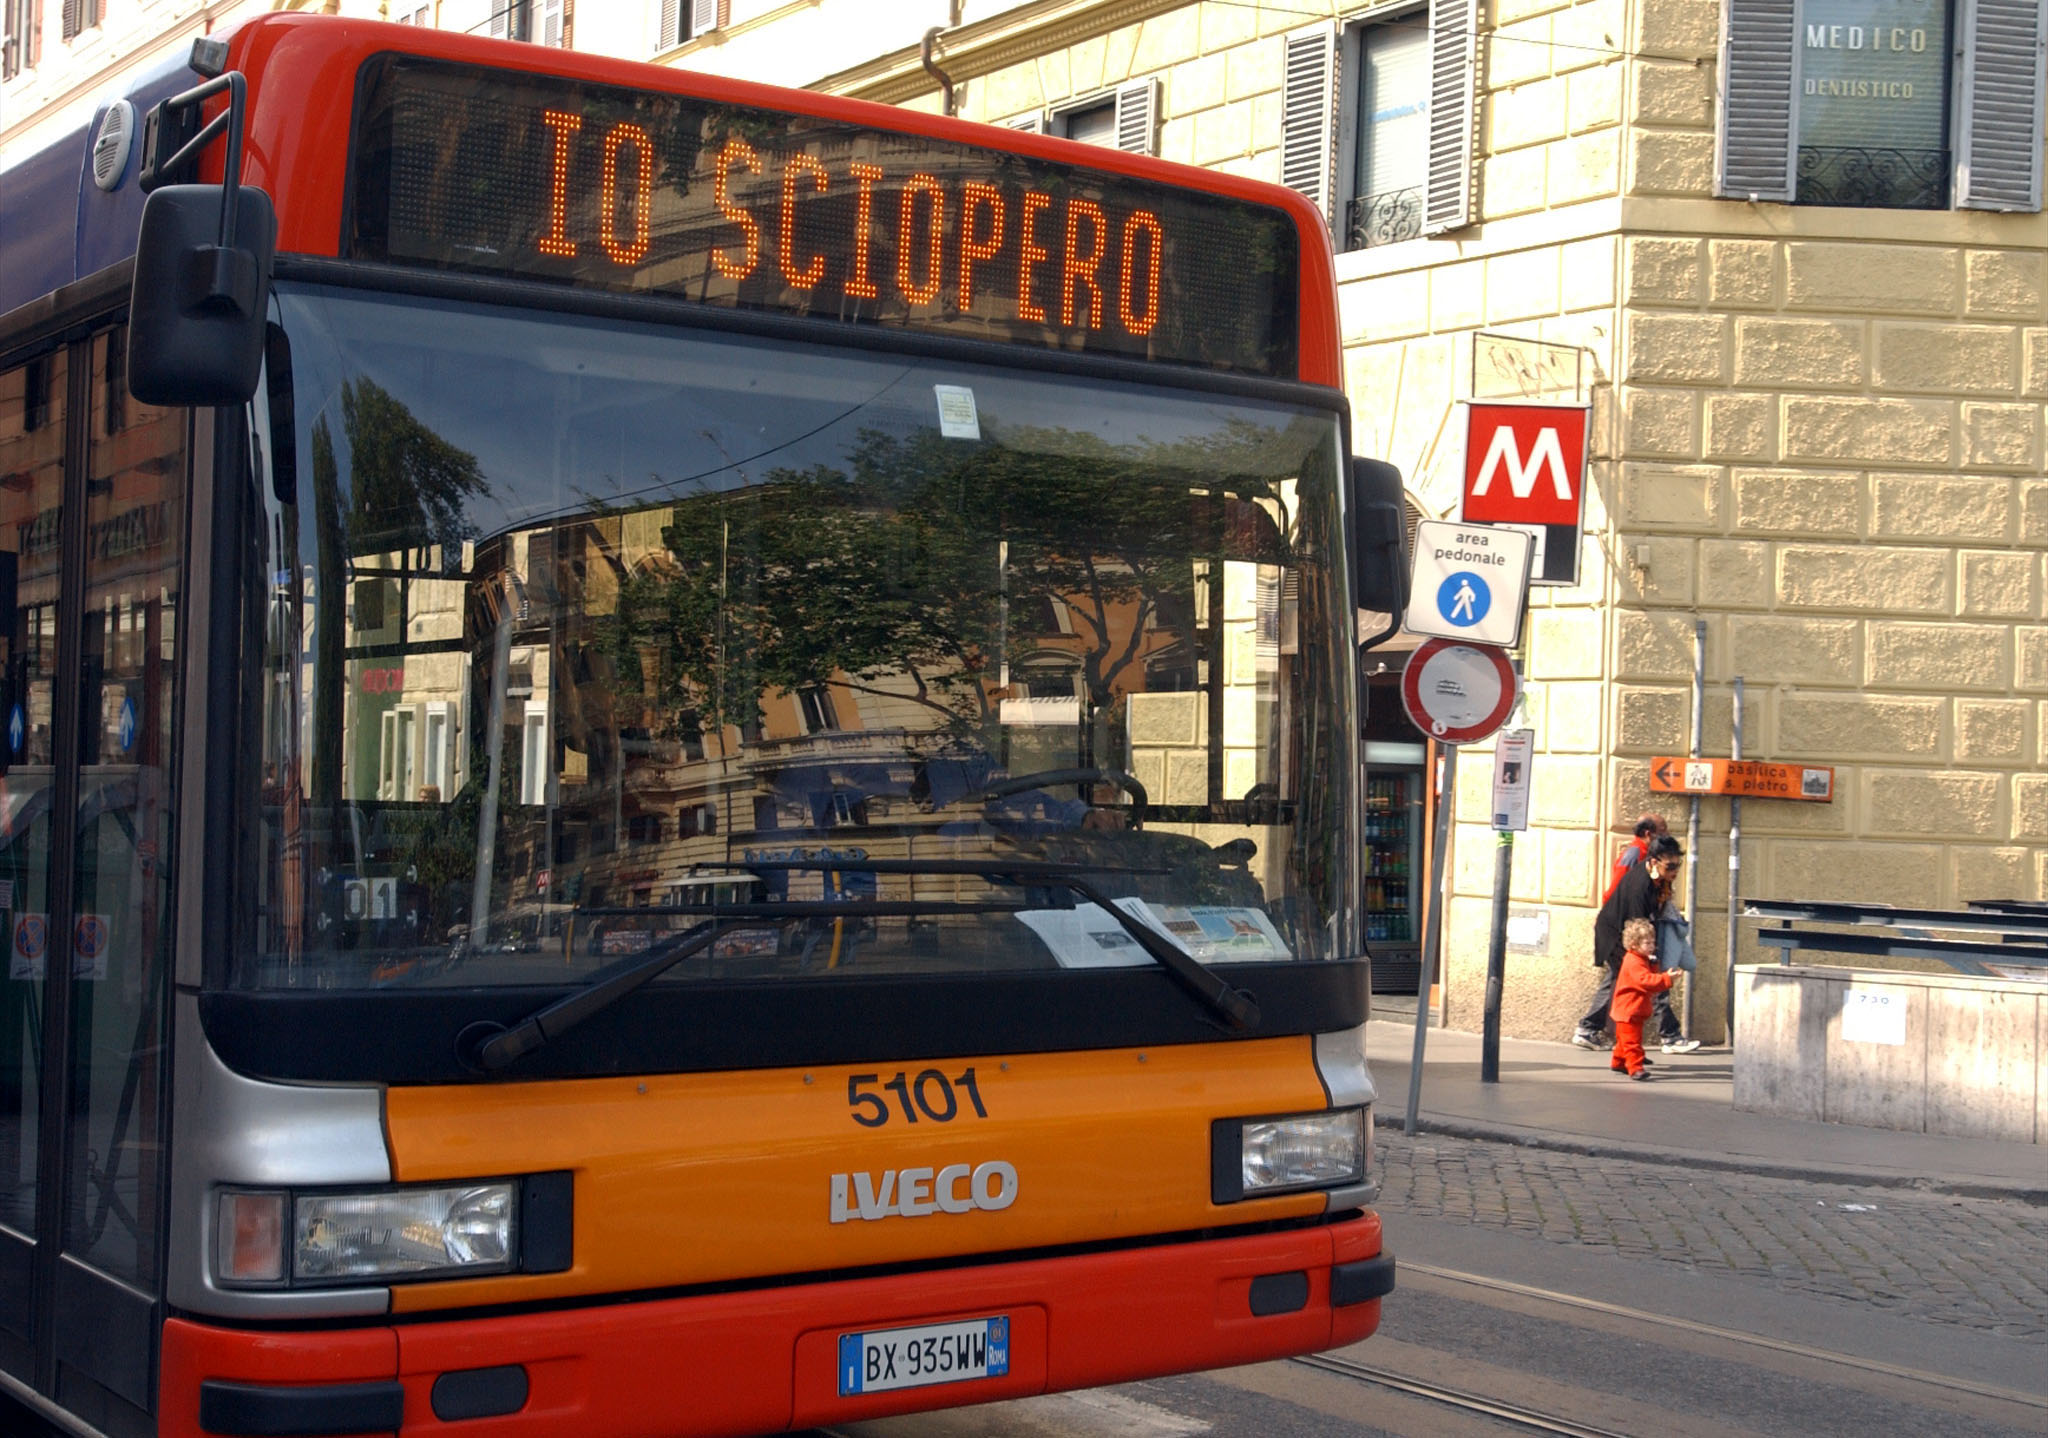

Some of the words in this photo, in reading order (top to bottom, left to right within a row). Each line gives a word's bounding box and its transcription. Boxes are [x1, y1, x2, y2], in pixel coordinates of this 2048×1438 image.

[1806, 24, 1926, 53] MEDICO
[1804, 79, 1913, 99] DENTISTICO
[539, 110, 653, 266] IO
[711, 140, 1163, 336] SCIOPERO
[1471, 425, 1573, 500] M
[1455, 533, 1489, 546] area
[1434, 548, 1506, 566] pedonale
[1727, 762, 1788, 777] basilica
[1743, 779, 1788, 792] pietro
[848, 1067, 988, 1128] 5101
[829, 1160, 1018, 1224] IVECO
[866, 1342, 897, 1382] BX
[907, 1331, 987, 1376] 935WW
